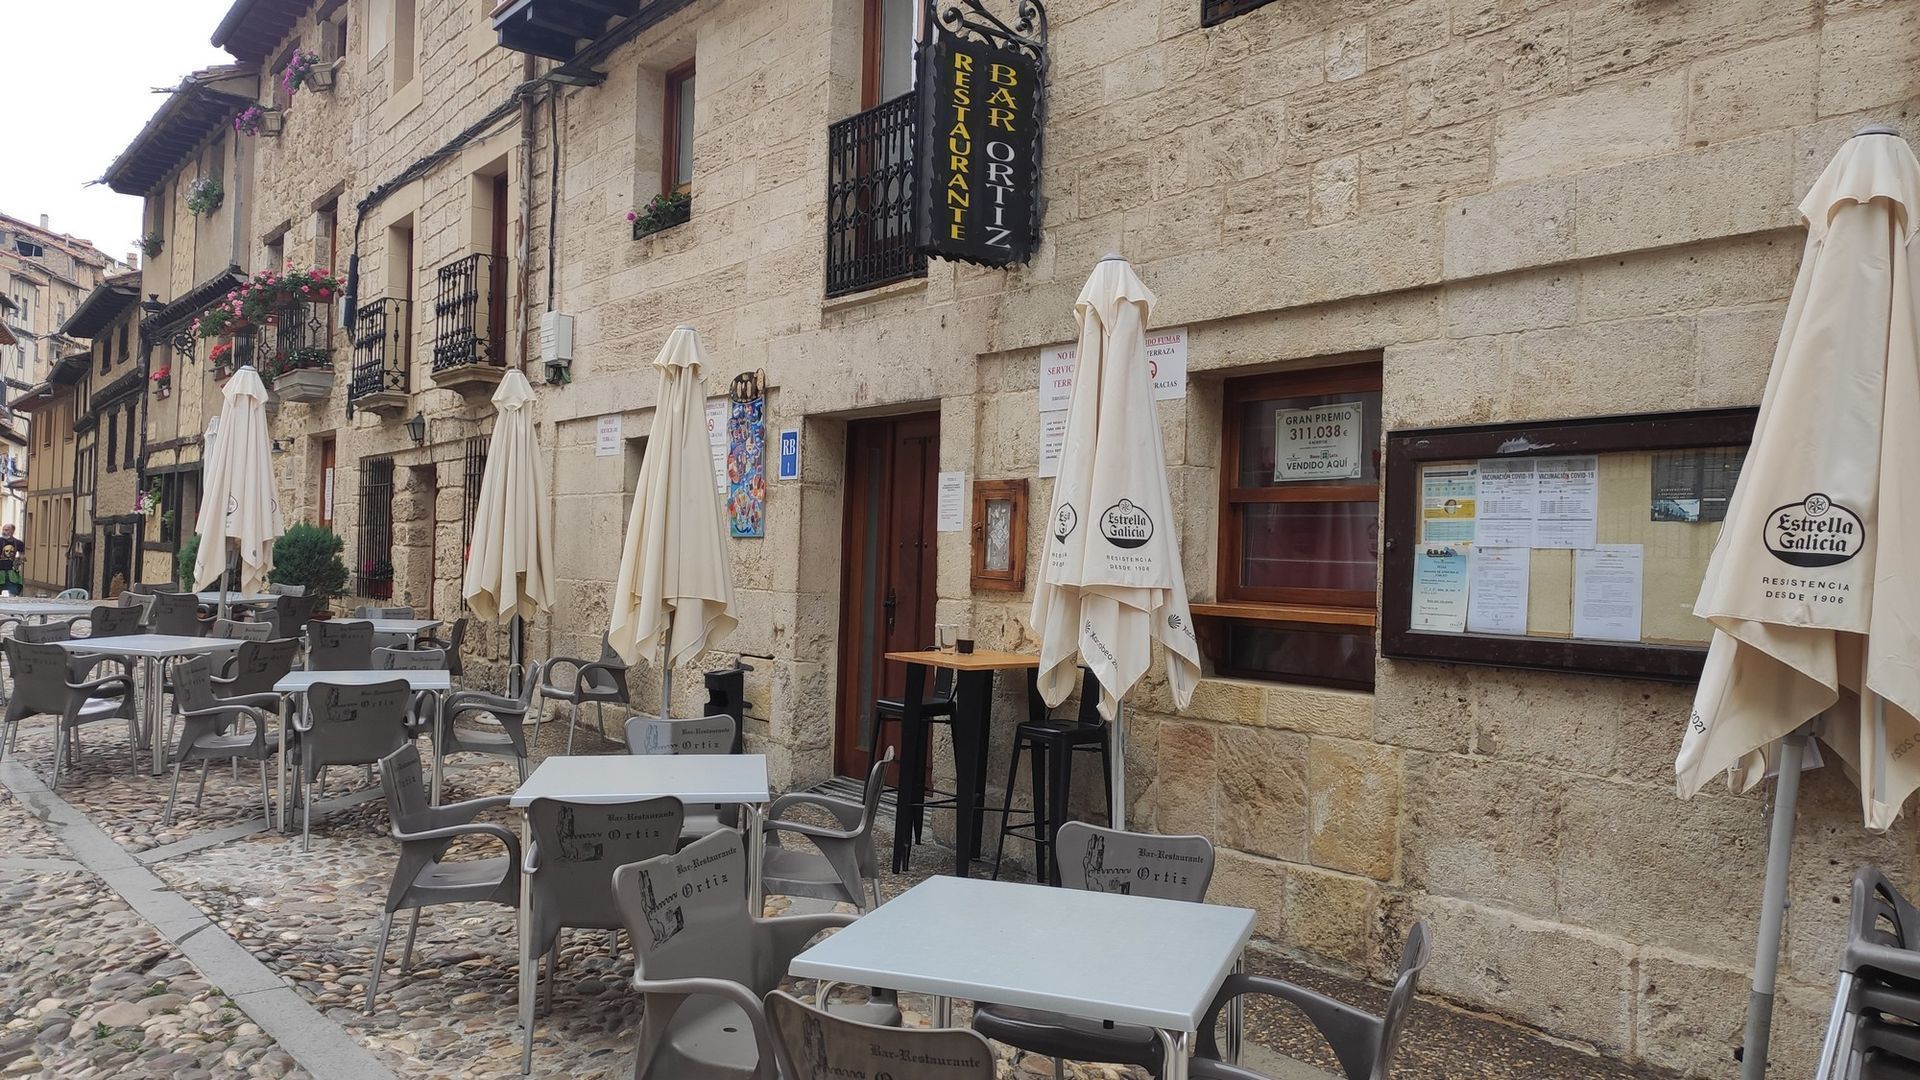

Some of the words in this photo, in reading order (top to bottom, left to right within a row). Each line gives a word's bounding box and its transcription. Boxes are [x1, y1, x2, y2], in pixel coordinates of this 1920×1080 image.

[986, 63, 1019, 132] BAR
[947, 52, 974, 241] RESTAURANTE
[984, 141, 1015, 249] ORTIZ
[1157, 335, 1182, 345] FUMAR
[1057, 351, 1068, 361] NO
[1047, 365, 1075, 376] SERVIC
[1053, 378, 1072, 388] TERR
[1153, 380, 1178, 389] RACIAS
[1286, 415, 1313, 426] GRAN
[1315, 411, 1352, 422] PREMIO
[1290, 424, 1341, 441] 311.038
[783, 438, 796, 456] RB
[1286, 460, 1325, 471] VENDIDO
[1326, 456, 1348, 468] AQUÍ
[1512, 472, 1534, 480] COVID-19
[1108, 512, 1147, 526] Estrella
[1777, 513, 1854, 535] Estrella
[1110, 524, 1146, 538] Galicia
[1779, 531, 1848, 553] Galicia
[1106, 554, 1153, 563] RESISTENCIA
[1762, 576, 1850, 592] RESISTENCIA
[1765, 590, 1806, 602] DESDE
[1812, 594, 1845, 605] 1906
[608, 828, 660, 840] Ortiz
[676, 847, 737, 875] Bar-Restaurante
[1137, 847, 1204, 864] Bar-Restaurante
[1137, 866, 1188, 884] Ortiz
[682, 873, 729, 899] Ortiz
[869, 1043, 981, 1068] Bar-Restaurante
